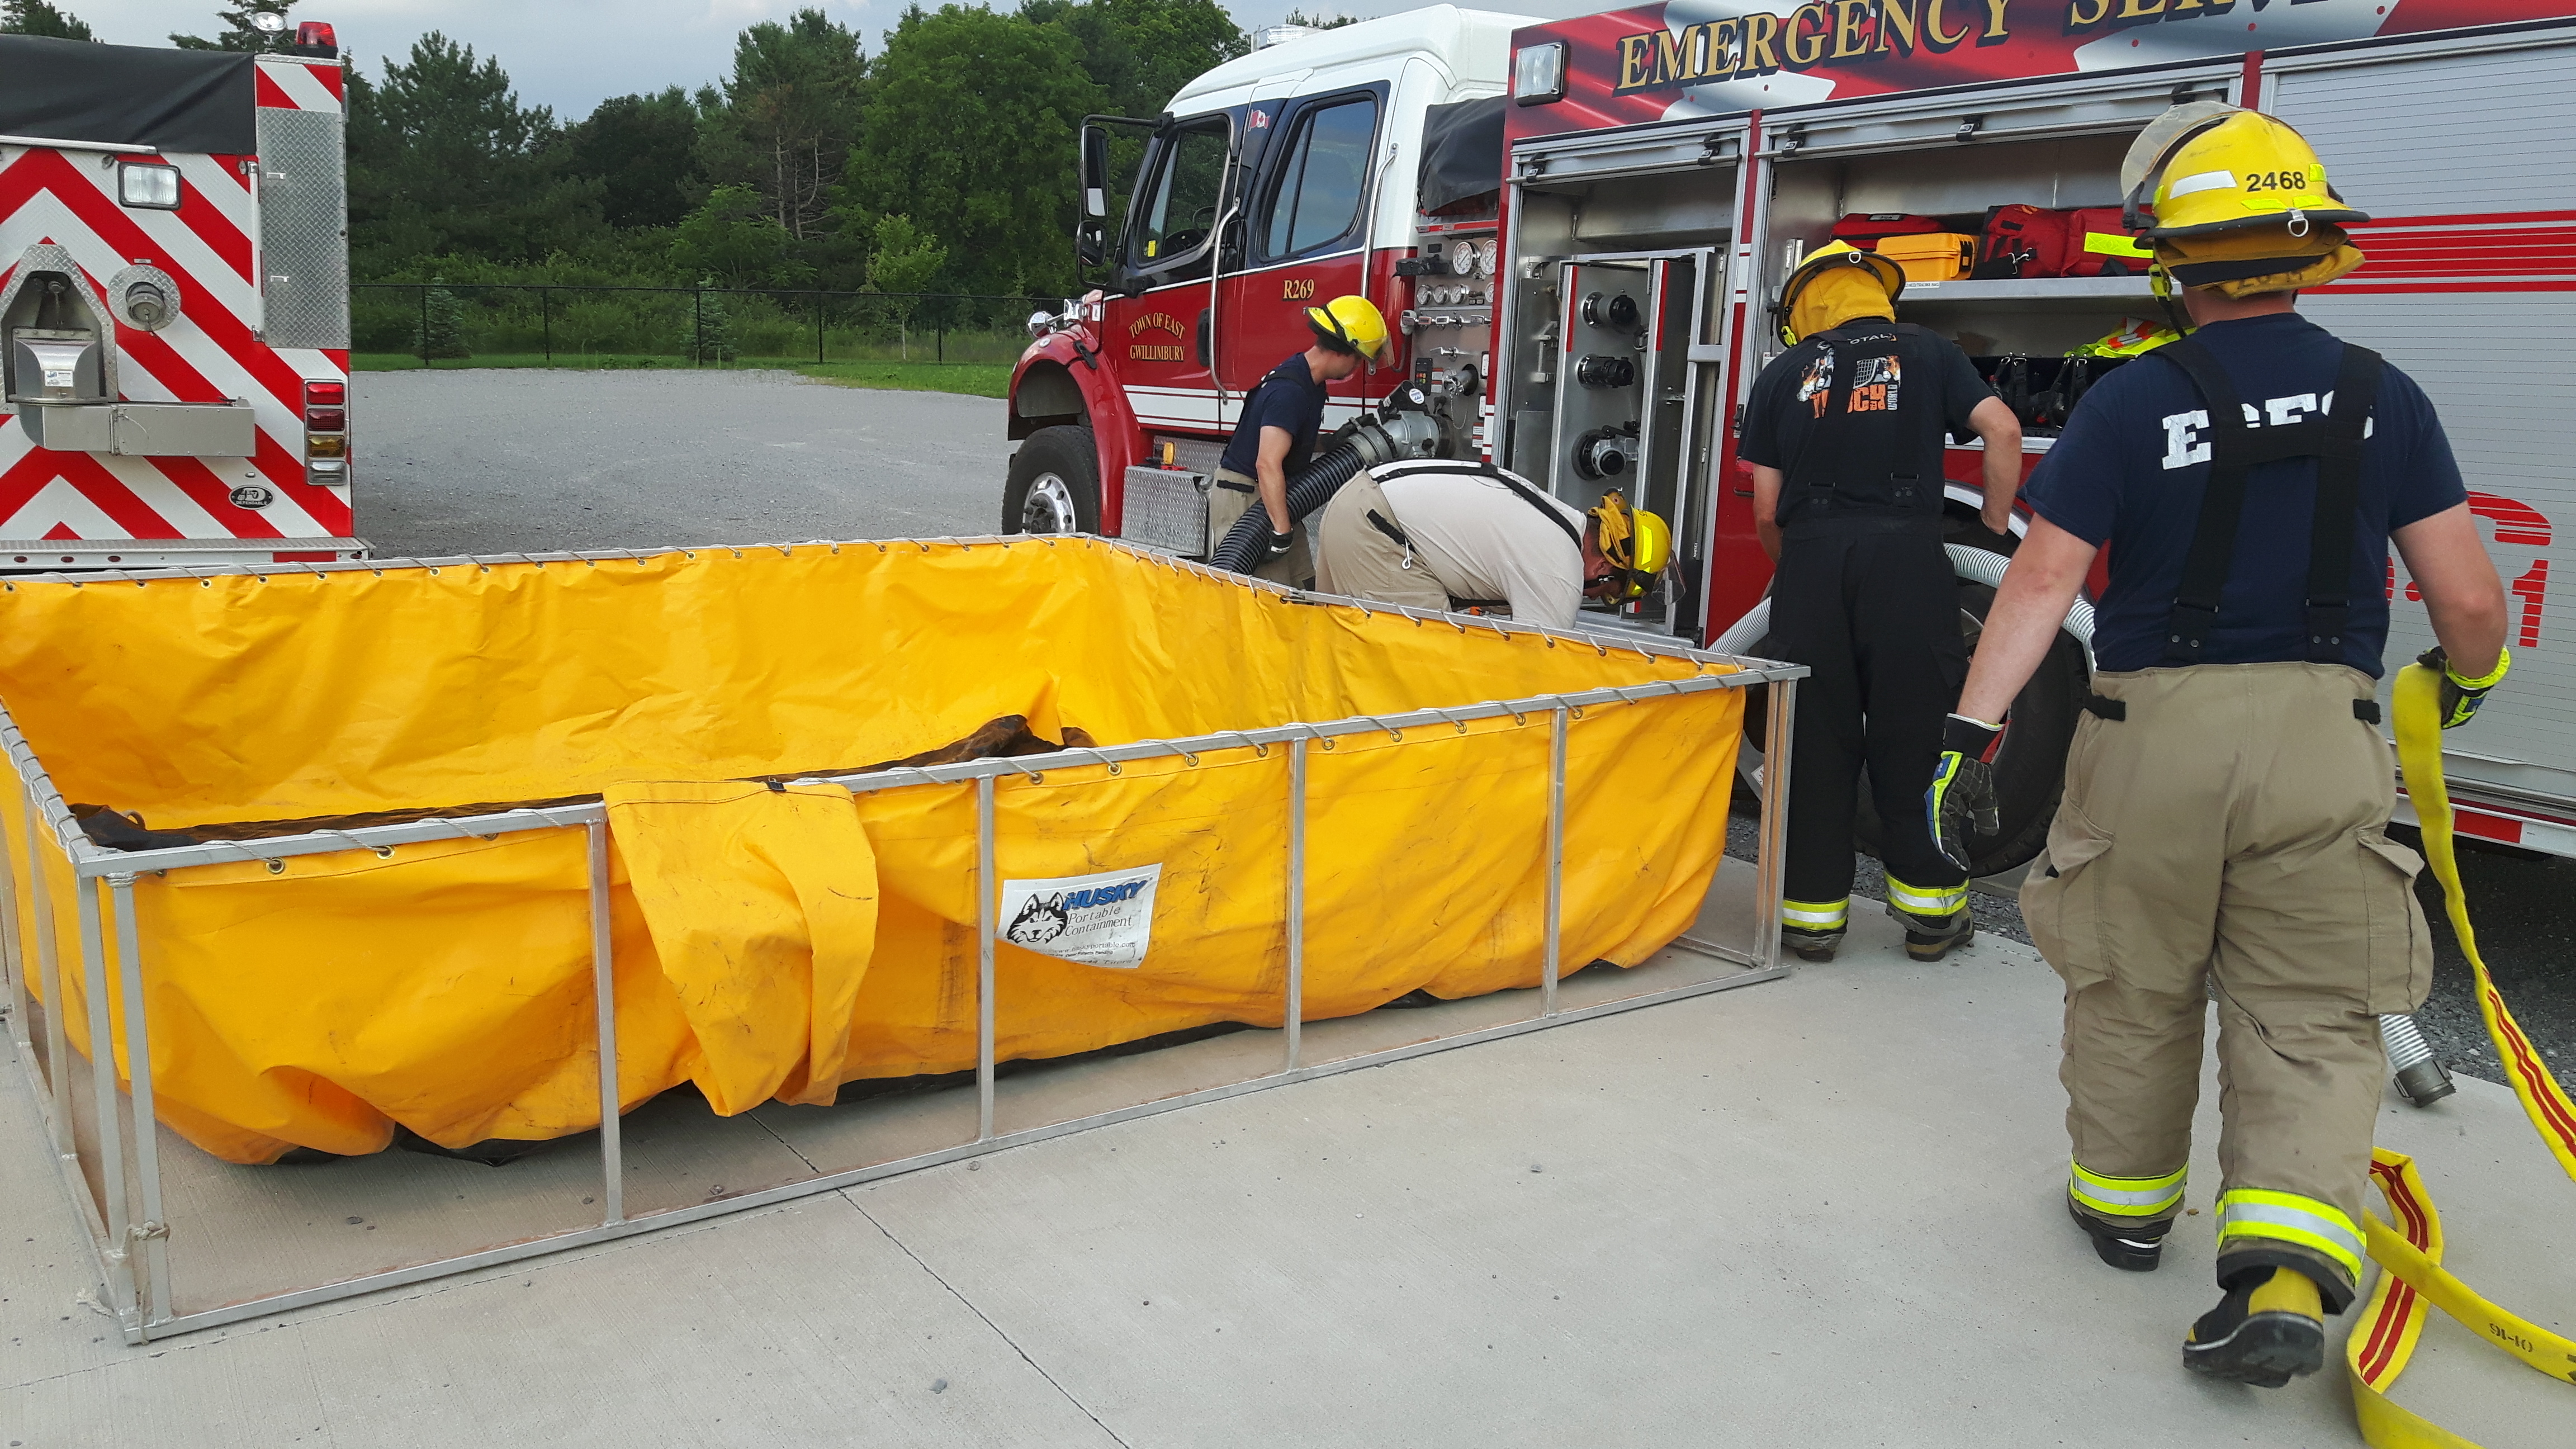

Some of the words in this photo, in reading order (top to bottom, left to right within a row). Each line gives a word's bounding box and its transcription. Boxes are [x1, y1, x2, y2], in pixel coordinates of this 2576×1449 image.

[1613, 0, 2011, 92] EMERGENCY
[2246, 171, 2306, 192] 2468
[1282, 278, 1315, 300] R269
[1129, 314, 1152, 339] TOWN
[1153, 312, 1164, 328] OF
[1164, 314, 1186, 341] EAST
[1130, 344, 1185, 361] GWILLIMBURY
[1887, 384, 1898, 411] WORLD
[1062, 880, 1148, 911] HUSKY
[1065, 915, 1133, 936] Containment
[1068, 906, 1121, 925] Portable
